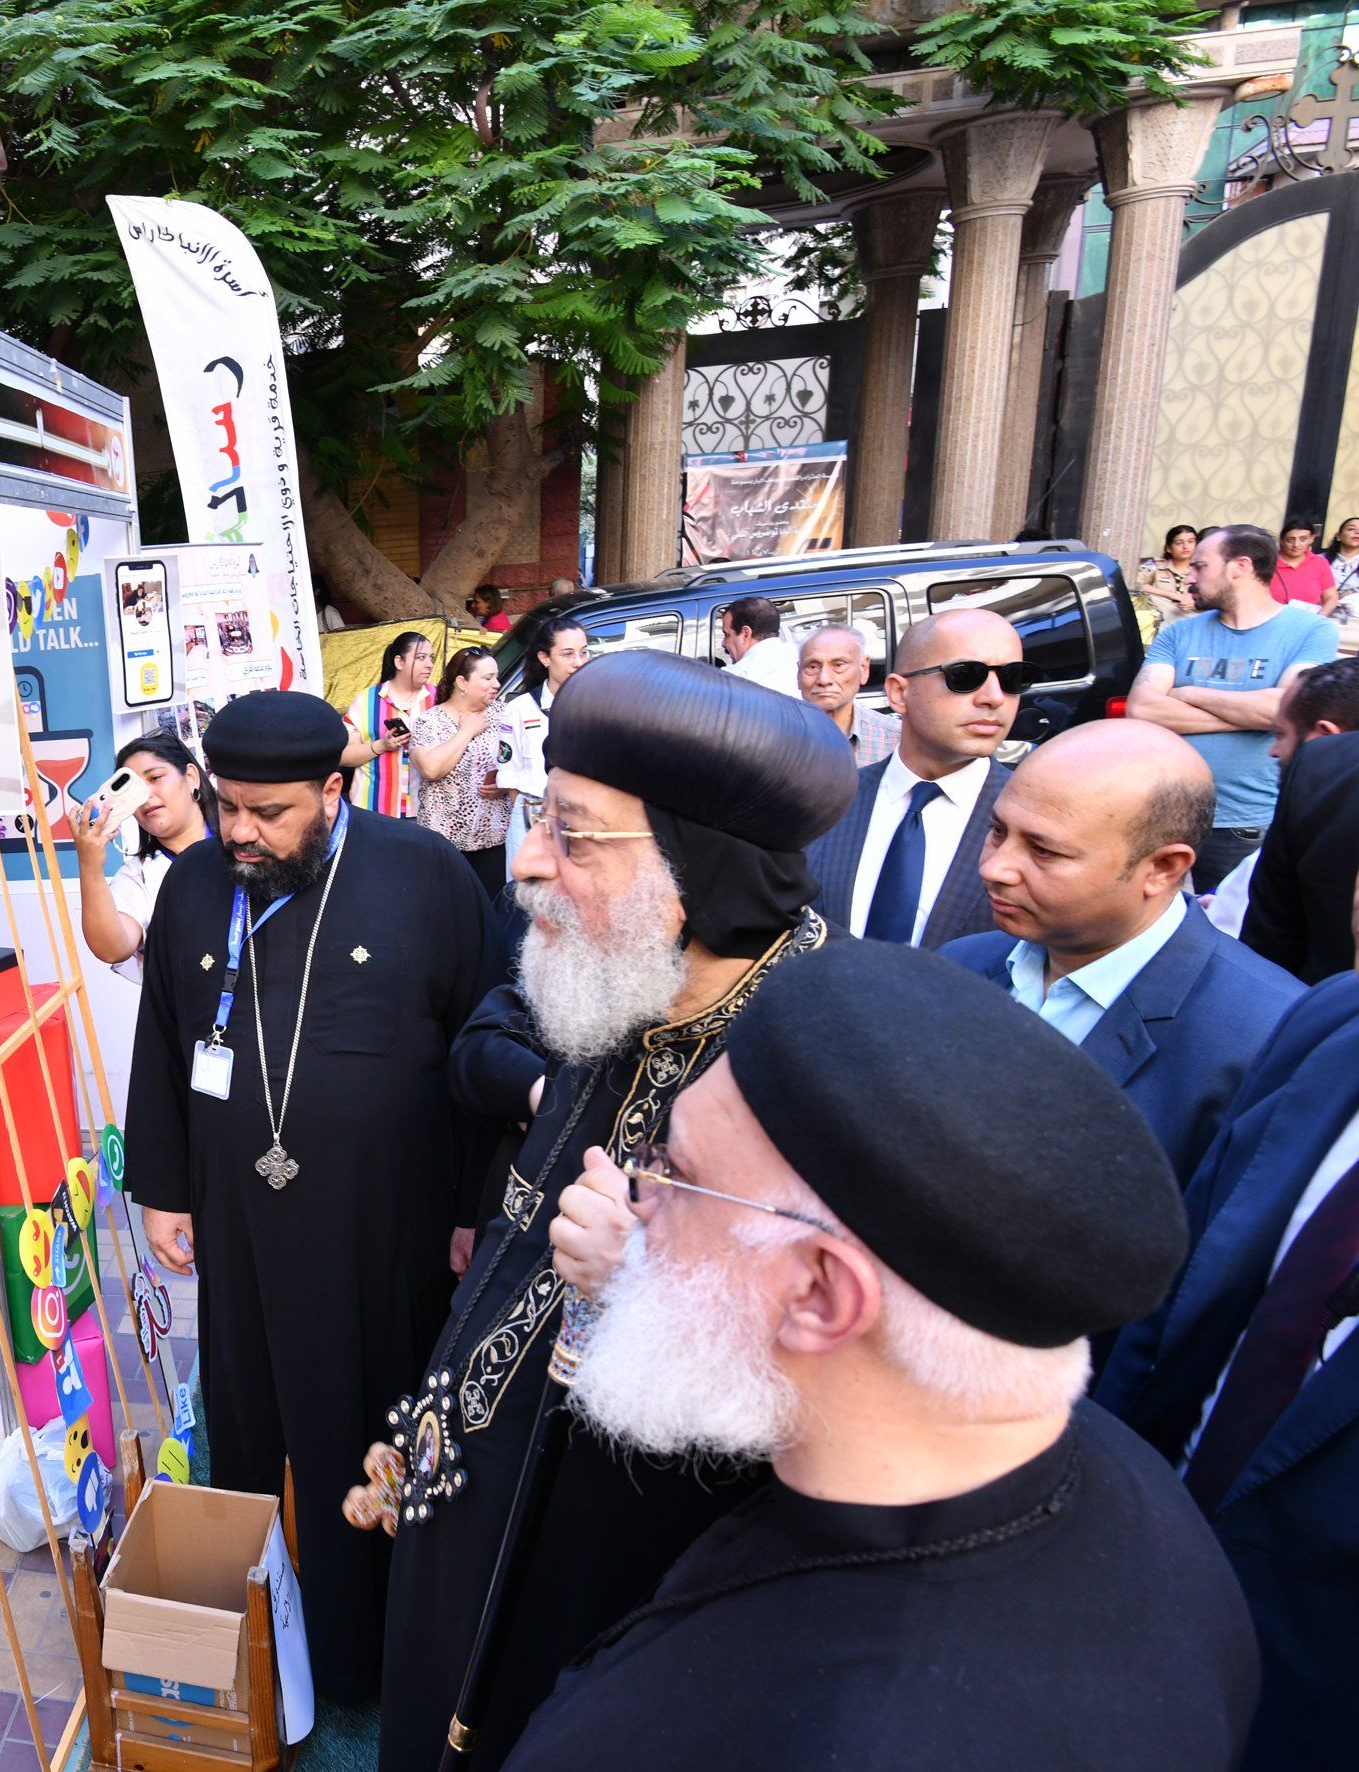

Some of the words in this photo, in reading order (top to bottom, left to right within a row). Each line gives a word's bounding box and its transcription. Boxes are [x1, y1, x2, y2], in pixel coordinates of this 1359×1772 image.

[179, 232, 222, 264] الانبا
[213, 259, 269, 297] أسرة
[263, 354, 278, 409] خدمة
[281, 515, 300, 615] الاحتياجات
[730, 500, 772, 517] الشباب
[179, 1388, 192, 1425] Like
